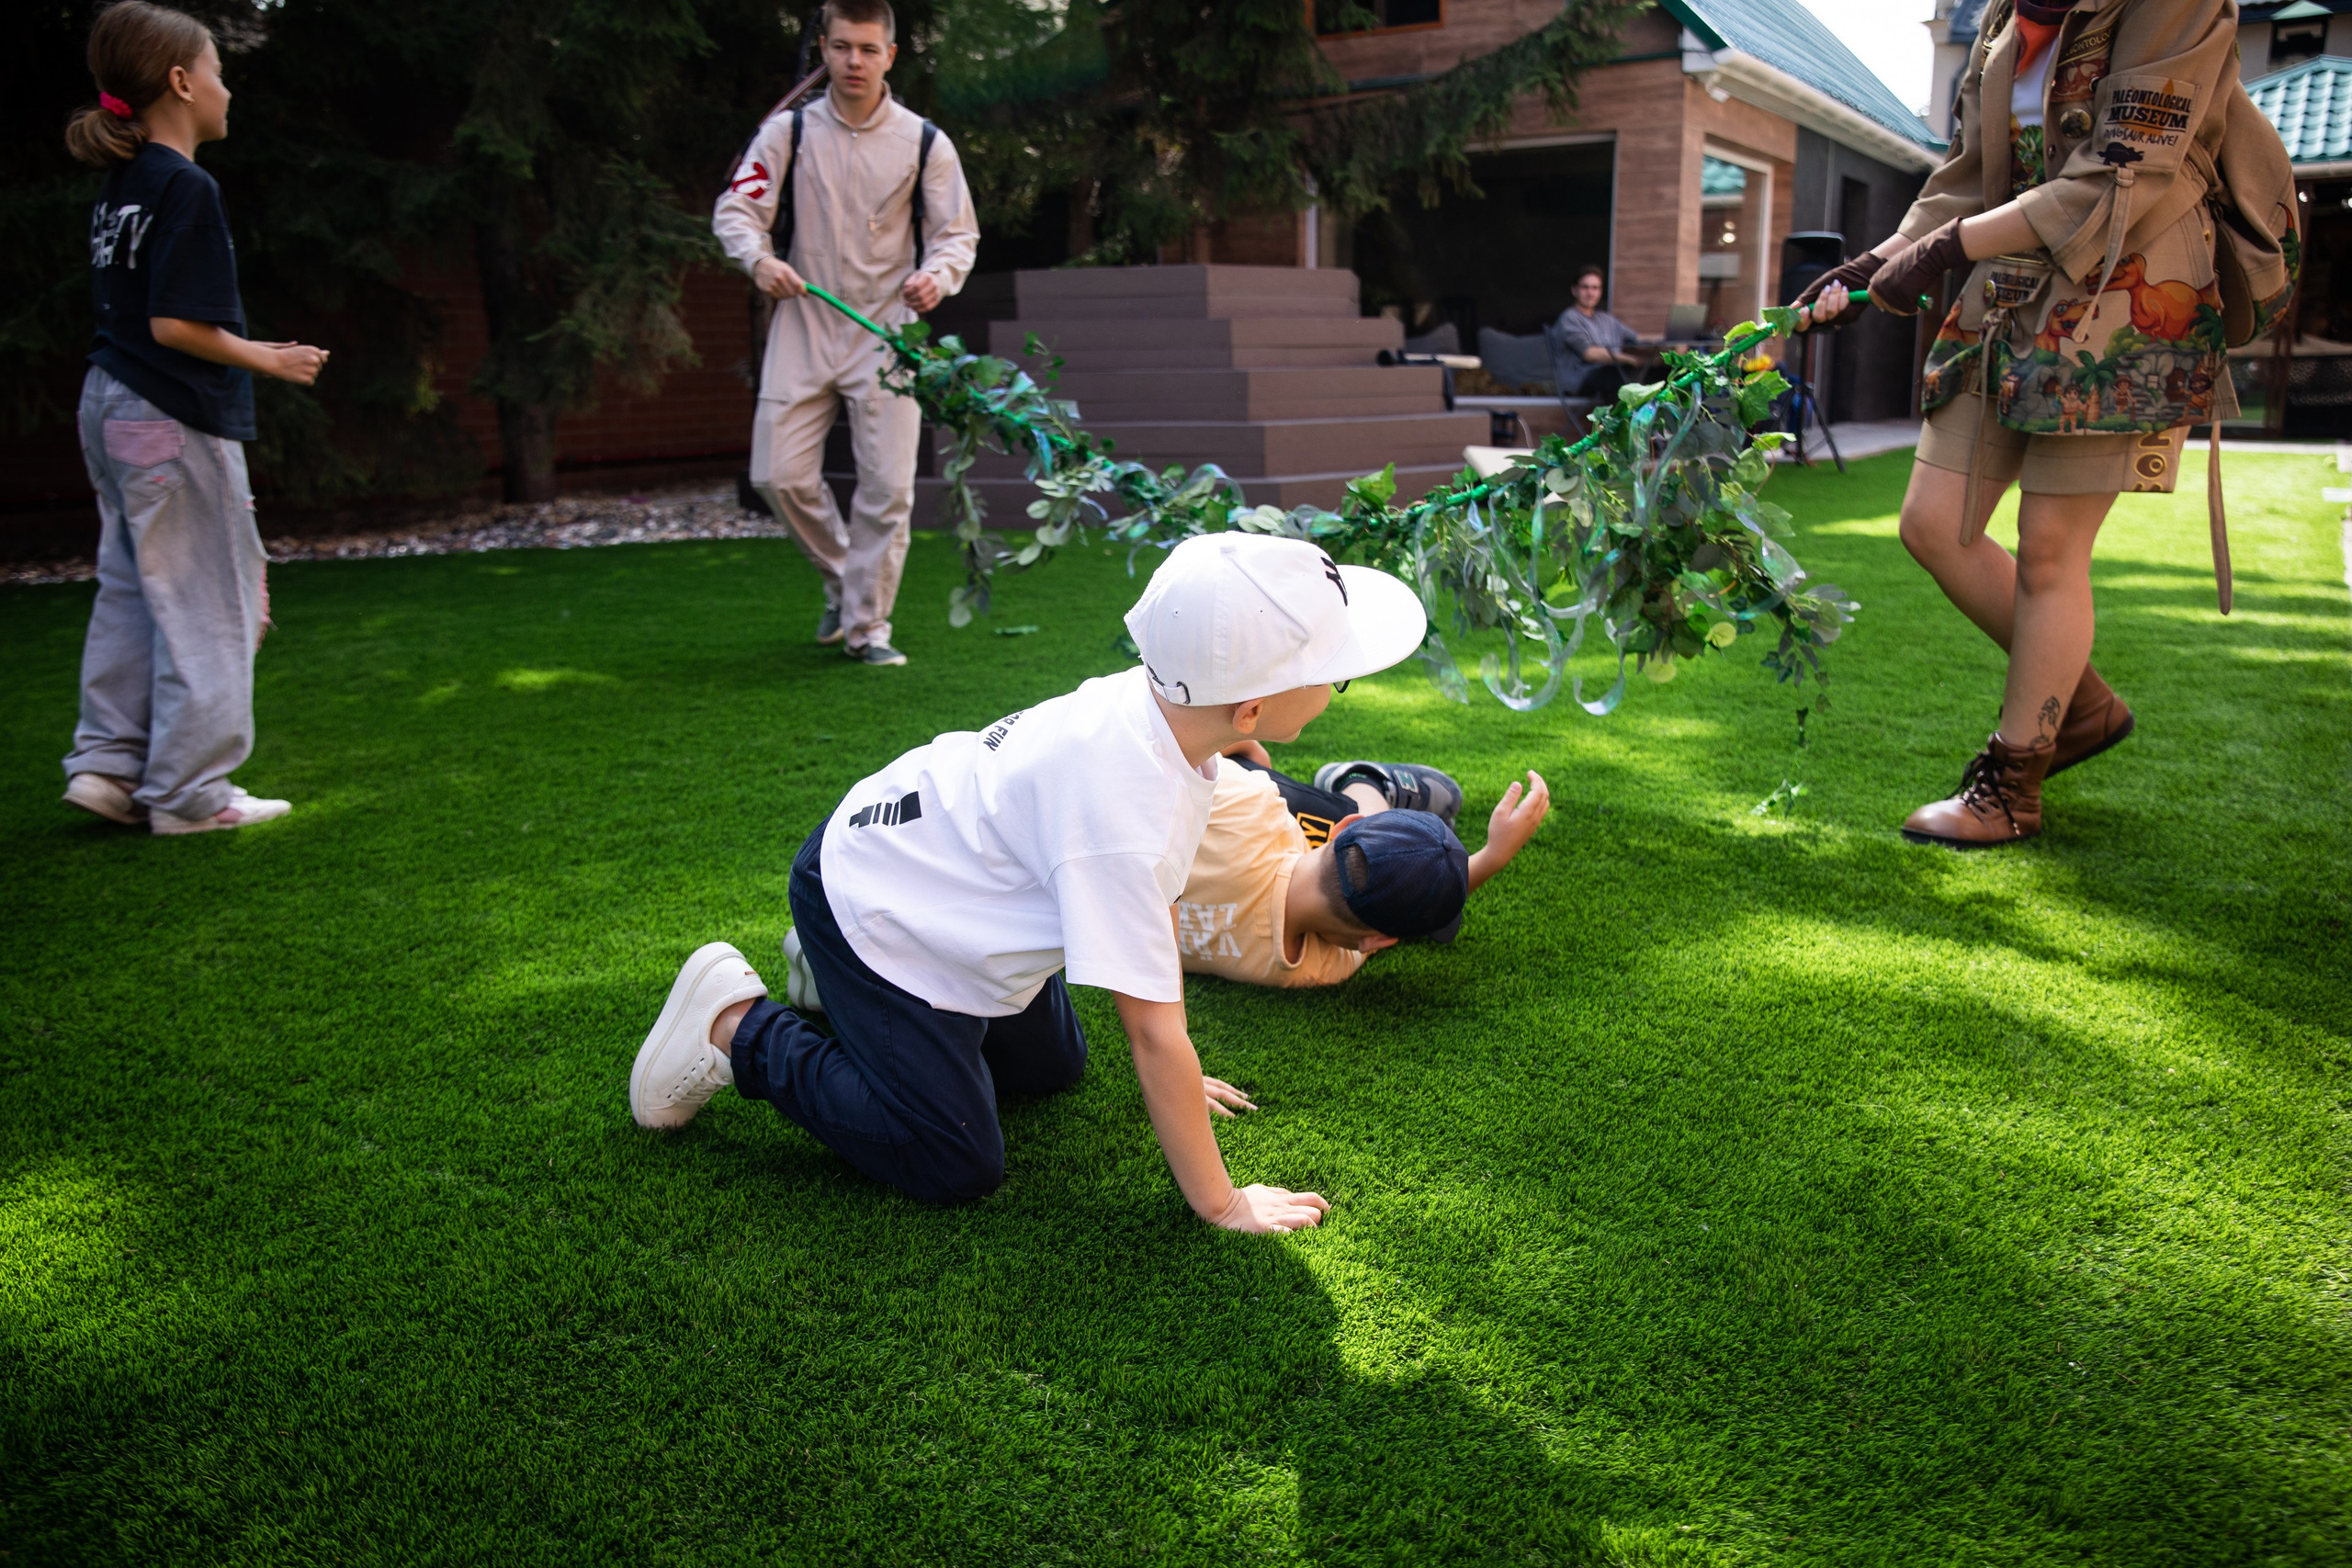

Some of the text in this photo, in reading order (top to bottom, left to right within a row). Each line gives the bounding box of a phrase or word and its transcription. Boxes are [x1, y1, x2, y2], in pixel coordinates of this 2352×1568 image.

[2108, 106, 2188, 129] MUSEUM
[2103, 128, 2178, 147] DINOSAUR ALIVE!
[983, 725, 1009, 751] FUN
